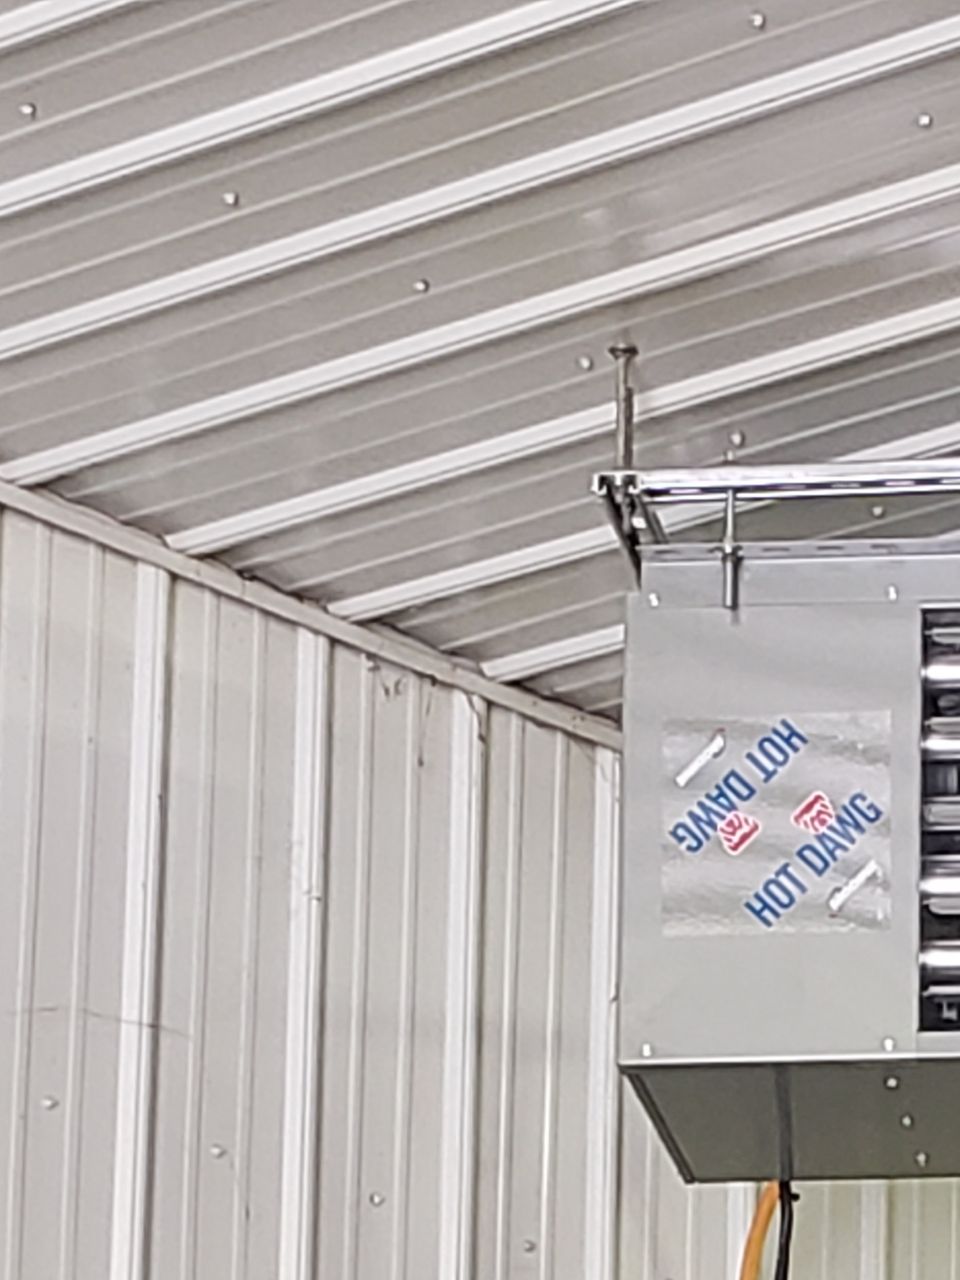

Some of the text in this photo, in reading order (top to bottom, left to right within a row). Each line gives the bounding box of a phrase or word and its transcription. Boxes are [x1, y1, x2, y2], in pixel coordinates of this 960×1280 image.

[668, 719, 808, 853] HOT DAWG
[744, 791, 883, 927] HOT DAWG
